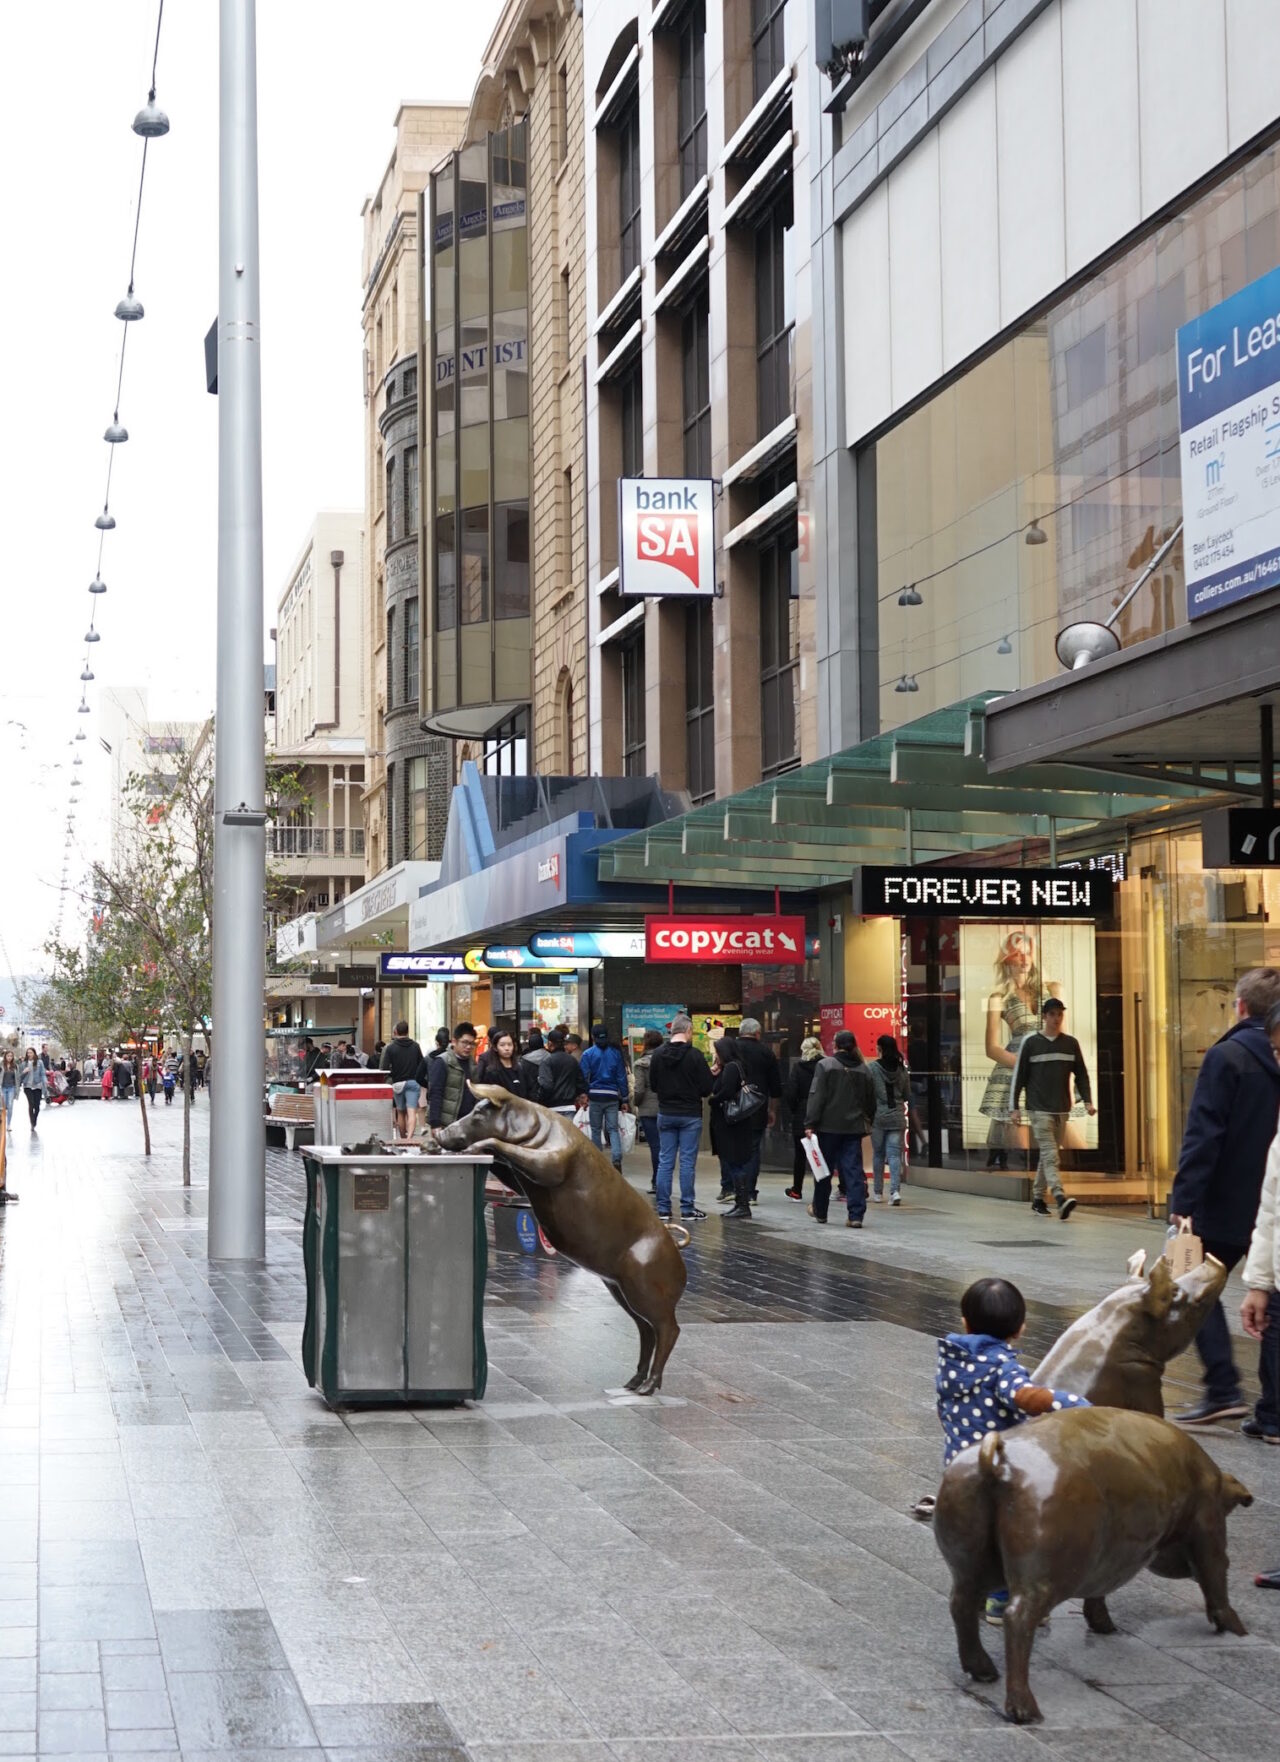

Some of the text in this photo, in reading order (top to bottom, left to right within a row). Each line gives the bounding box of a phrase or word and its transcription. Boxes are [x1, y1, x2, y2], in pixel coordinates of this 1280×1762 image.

[436, 339, 526, 382] DENTIST
[1187, 345, 1227, 393] For
[1190, 428, 1219, 458] Retail
[1221, 404, 1268, 441] Flagship
[636, 486, 698, 509] bank
[640, 516, 695, 557] SA
[1192, 543, 1206, 555] Ben
[884, 877, 1090, 906] FOREVER NEW
[655, 928, 775, 954] copycat
[722, 947, 754, 956] evening
